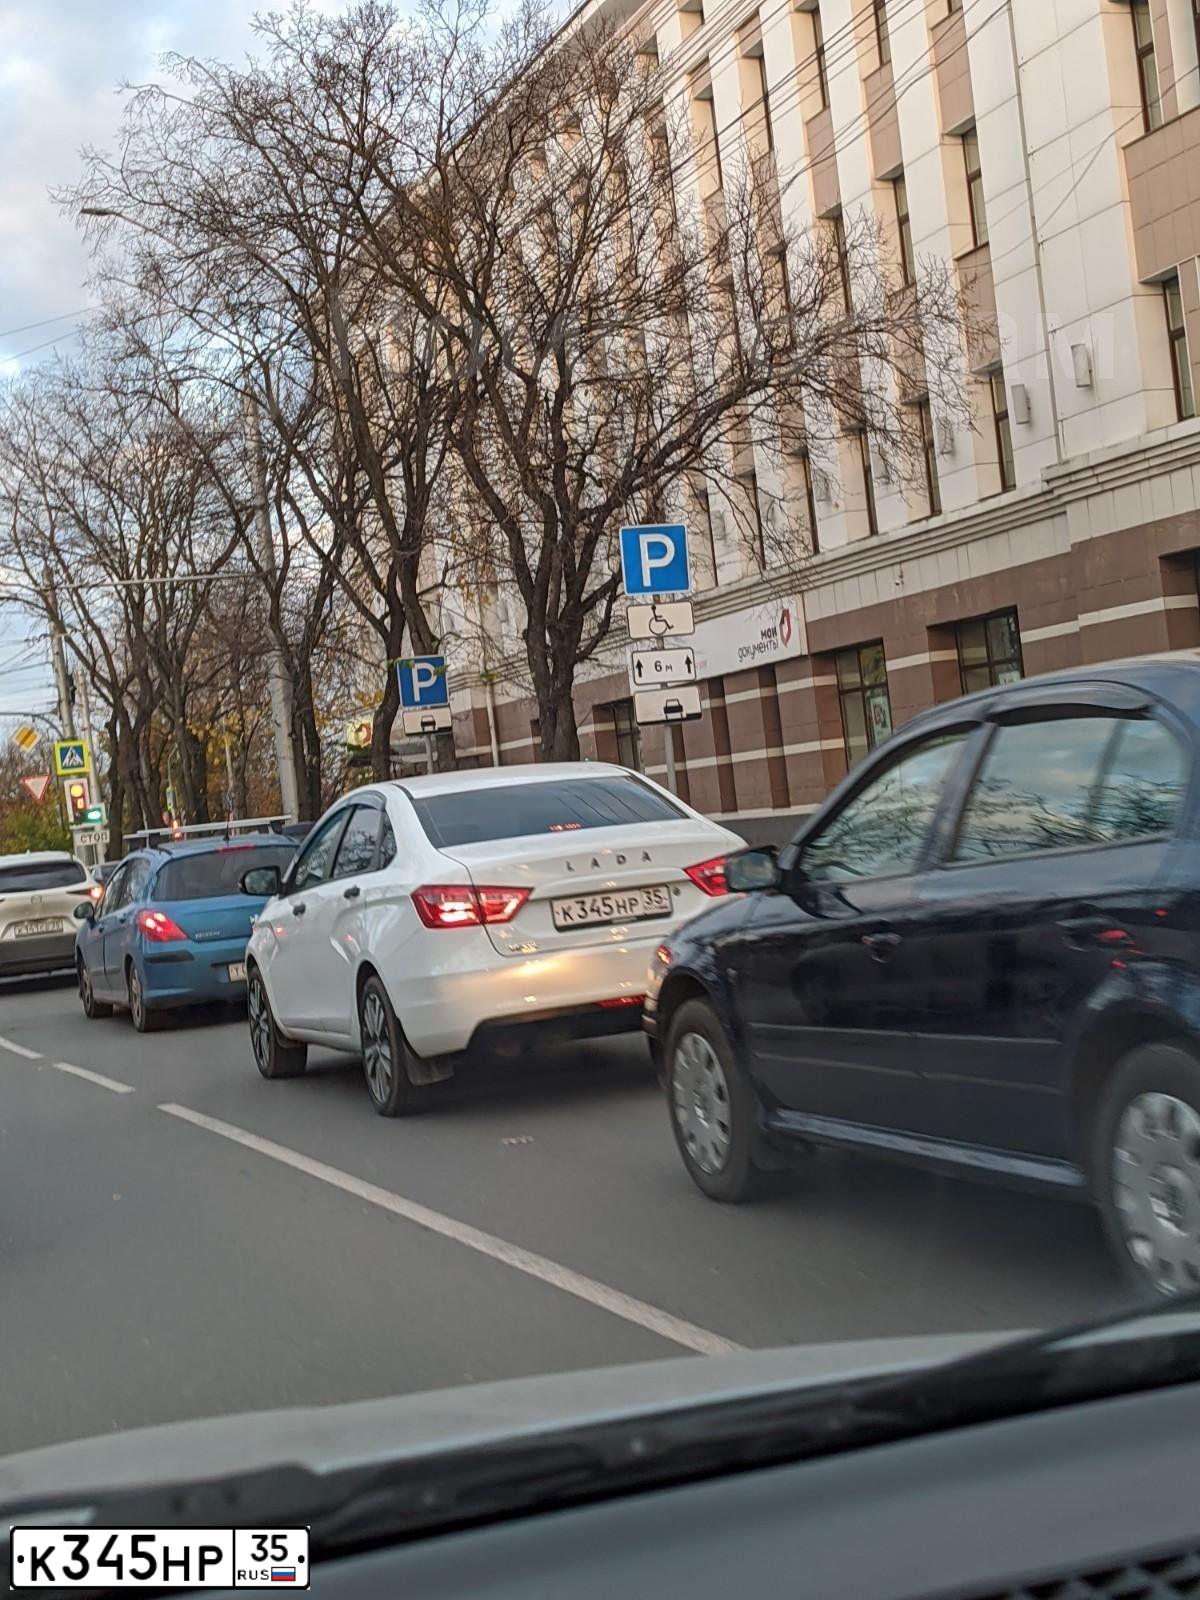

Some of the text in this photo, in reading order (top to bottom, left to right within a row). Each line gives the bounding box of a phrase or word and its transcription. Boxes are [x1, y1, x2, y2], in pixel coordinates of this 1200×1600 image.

[638, 533, 675, 587] P
[654, 660, 662, 672] 6
[412, 663, 437, 702] P
[80, 832, 107, 843] СТОП
[566, 851, 652, 871] LADA
[644, 889, 663, 905] 35
